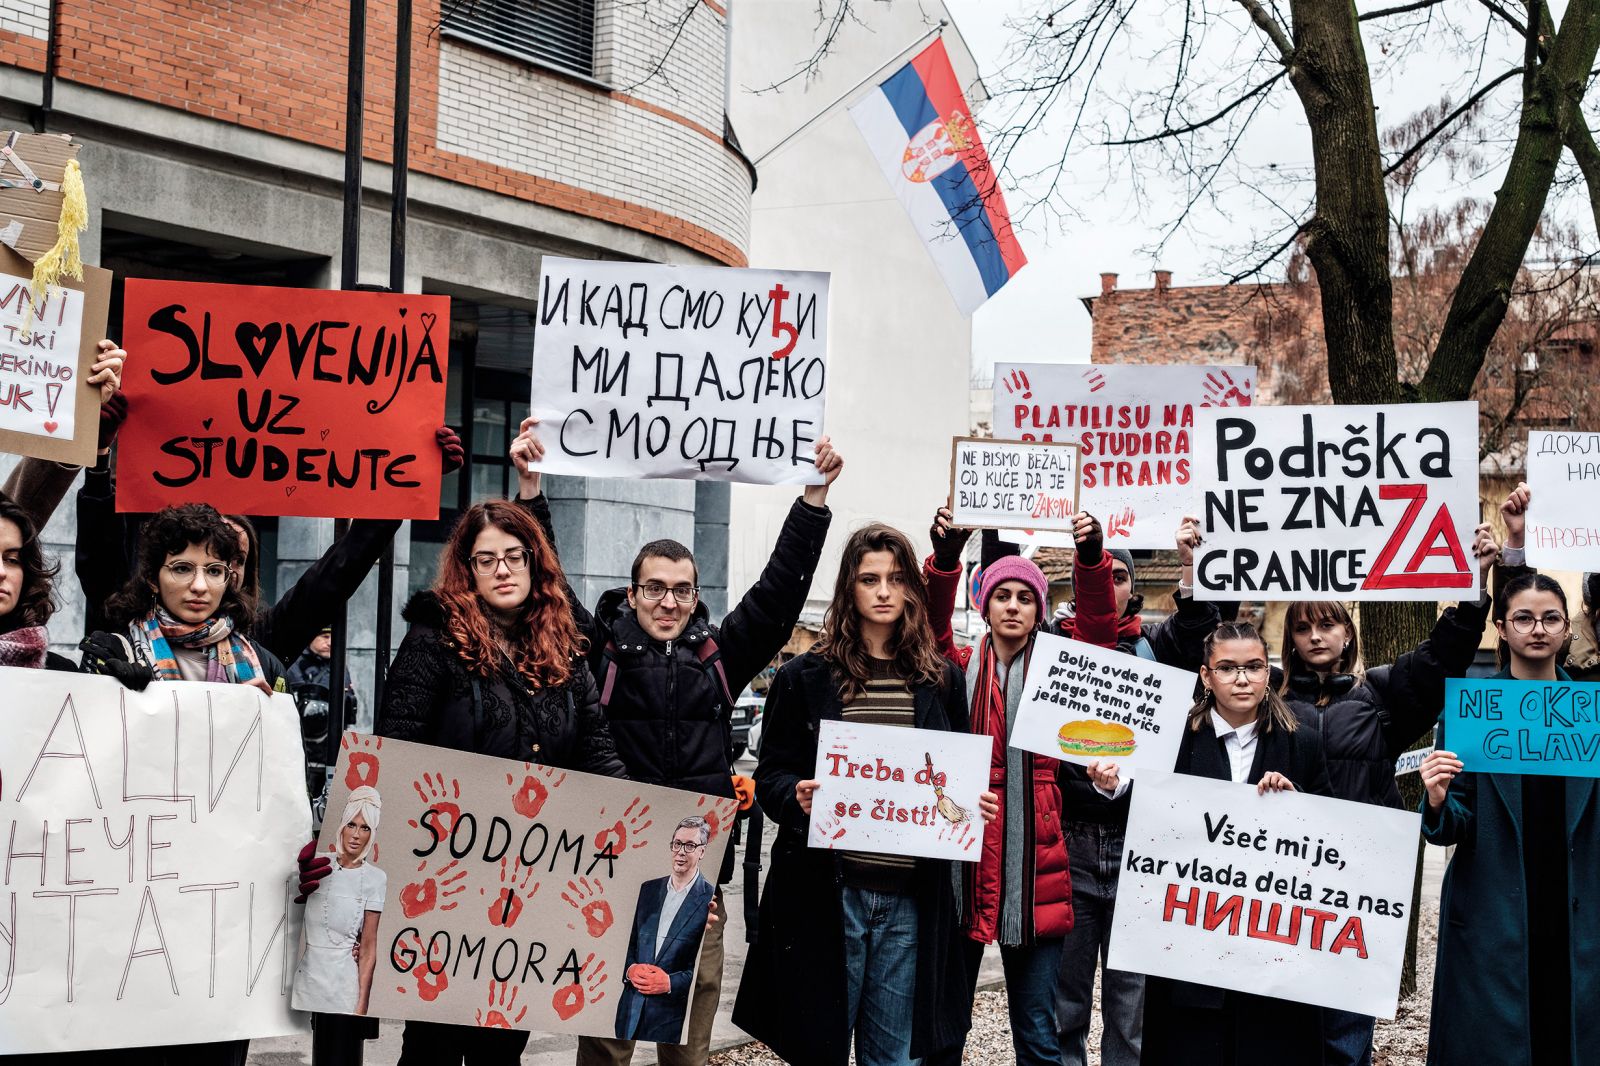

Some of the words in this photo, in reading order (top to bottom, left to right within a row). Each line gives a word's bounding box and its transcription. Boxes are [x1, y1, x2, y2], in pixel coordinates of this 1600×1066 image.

[541, 275, 569, 326] И
[579, 279, 648, 339] КАД
[659, 284, 724, 330] СМО
[571, 345, 630, 397] МИ
[647, 351, 825, 411] ДАЛЕКО
[237, 387, 306, 435] UZ
[152, 435, 422, 491] STUDENTE
[962, 450, 977, 466] NE
[982, 450, 1020, 468] BISMO
[1216, 412, 1453, 482] Podrška
[960, 469, 979, 486] OD
[985, 468, 1018, 489] KUĆE
[1025, 472, 1042, 490] DA
[1050, 474, 1065, 490] JE
[1567, 462, 1600, 482] НА
[959, 490, 988, 509] BILO
[993, 492, 1014, 511] SVE
[1205, 487, 1269, 532] NE
[1197, 547, 1367, 592] GRANICE
[1048, 665, 1112, 690] pravimo
[1117, 684, 1162, 704] snove
[1058, 650, 1097, 671] Bolje
[1101, 663, 1139, 683] ovde
[1143, 673, 1162, 689] da
[1032, 686, 1091, 713] jedemo
[1096, 705, 1161, 734] sendviče
[1050, 679, 1088, 698] nego
[1092, 690, 1131, 710] tamo
[1136, 702, 1155, 717] da
[1459, 689, 1502, 721] NE
[826, 752, 905, 782] Treba
[914, 763, 947, 788] da
[834, 801, 862, 818] se
[870, 798, 937, 826] čisti!
[1203, 811, 1267, 851] Všeč
[412, 808, 619, 879] SODOMA
[1126, 849, 1168, 876] kar
[1175, 857, 1247, 888] vlada
[1255, 871, 1312, 901] dela
[1319, 886, 1349, 909] za
[1357, 893, 1405, 918] nas
[502, 888, 514, 925] I
[1162, 883, 1369, 959] НИШТА
[390, 926, 583, 986] GOMORA
